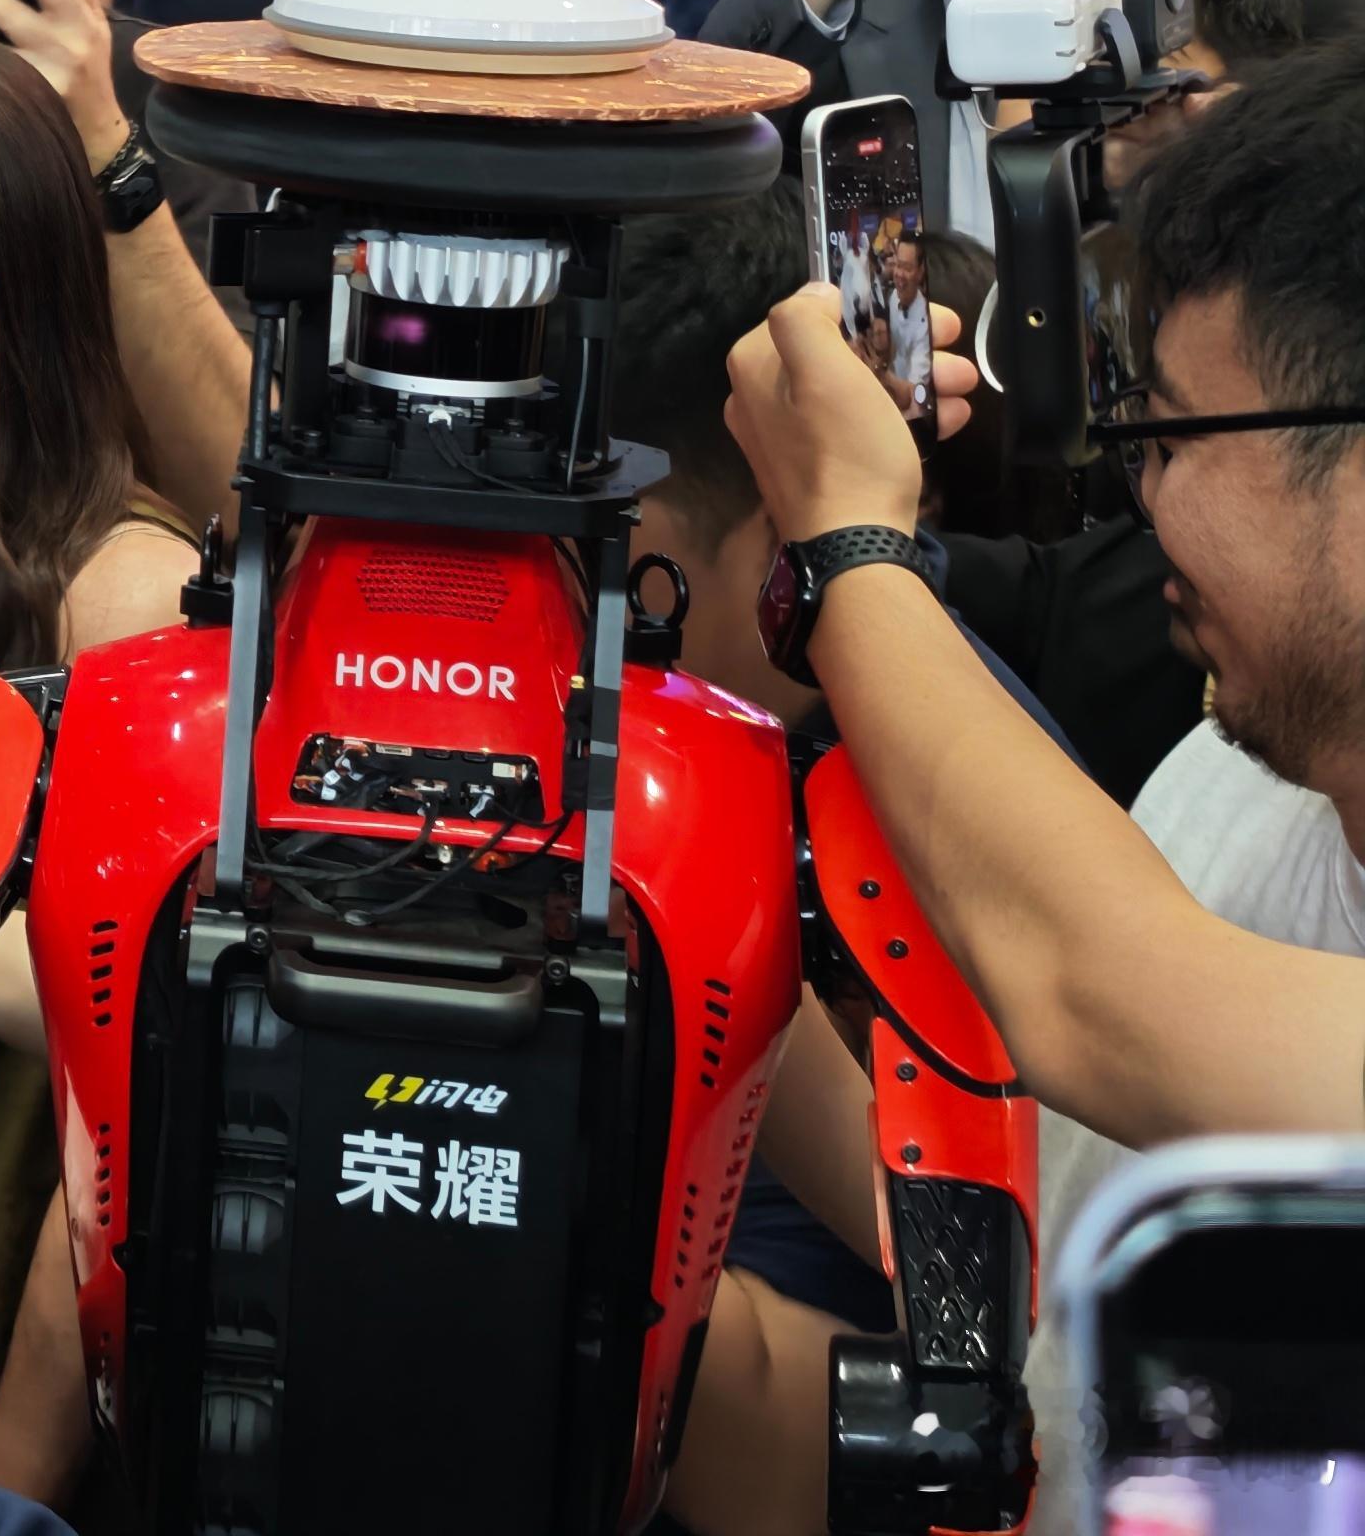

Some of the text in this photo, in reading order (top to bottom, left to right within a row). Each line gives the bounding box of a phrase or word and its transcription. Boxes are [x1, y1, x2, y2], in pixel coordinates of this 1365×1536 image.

[335, 652, 517, 702] HONOR
[413, 1078, 509, 1114] 闪电
[335, 1128, 521, 1227] 荣耀
